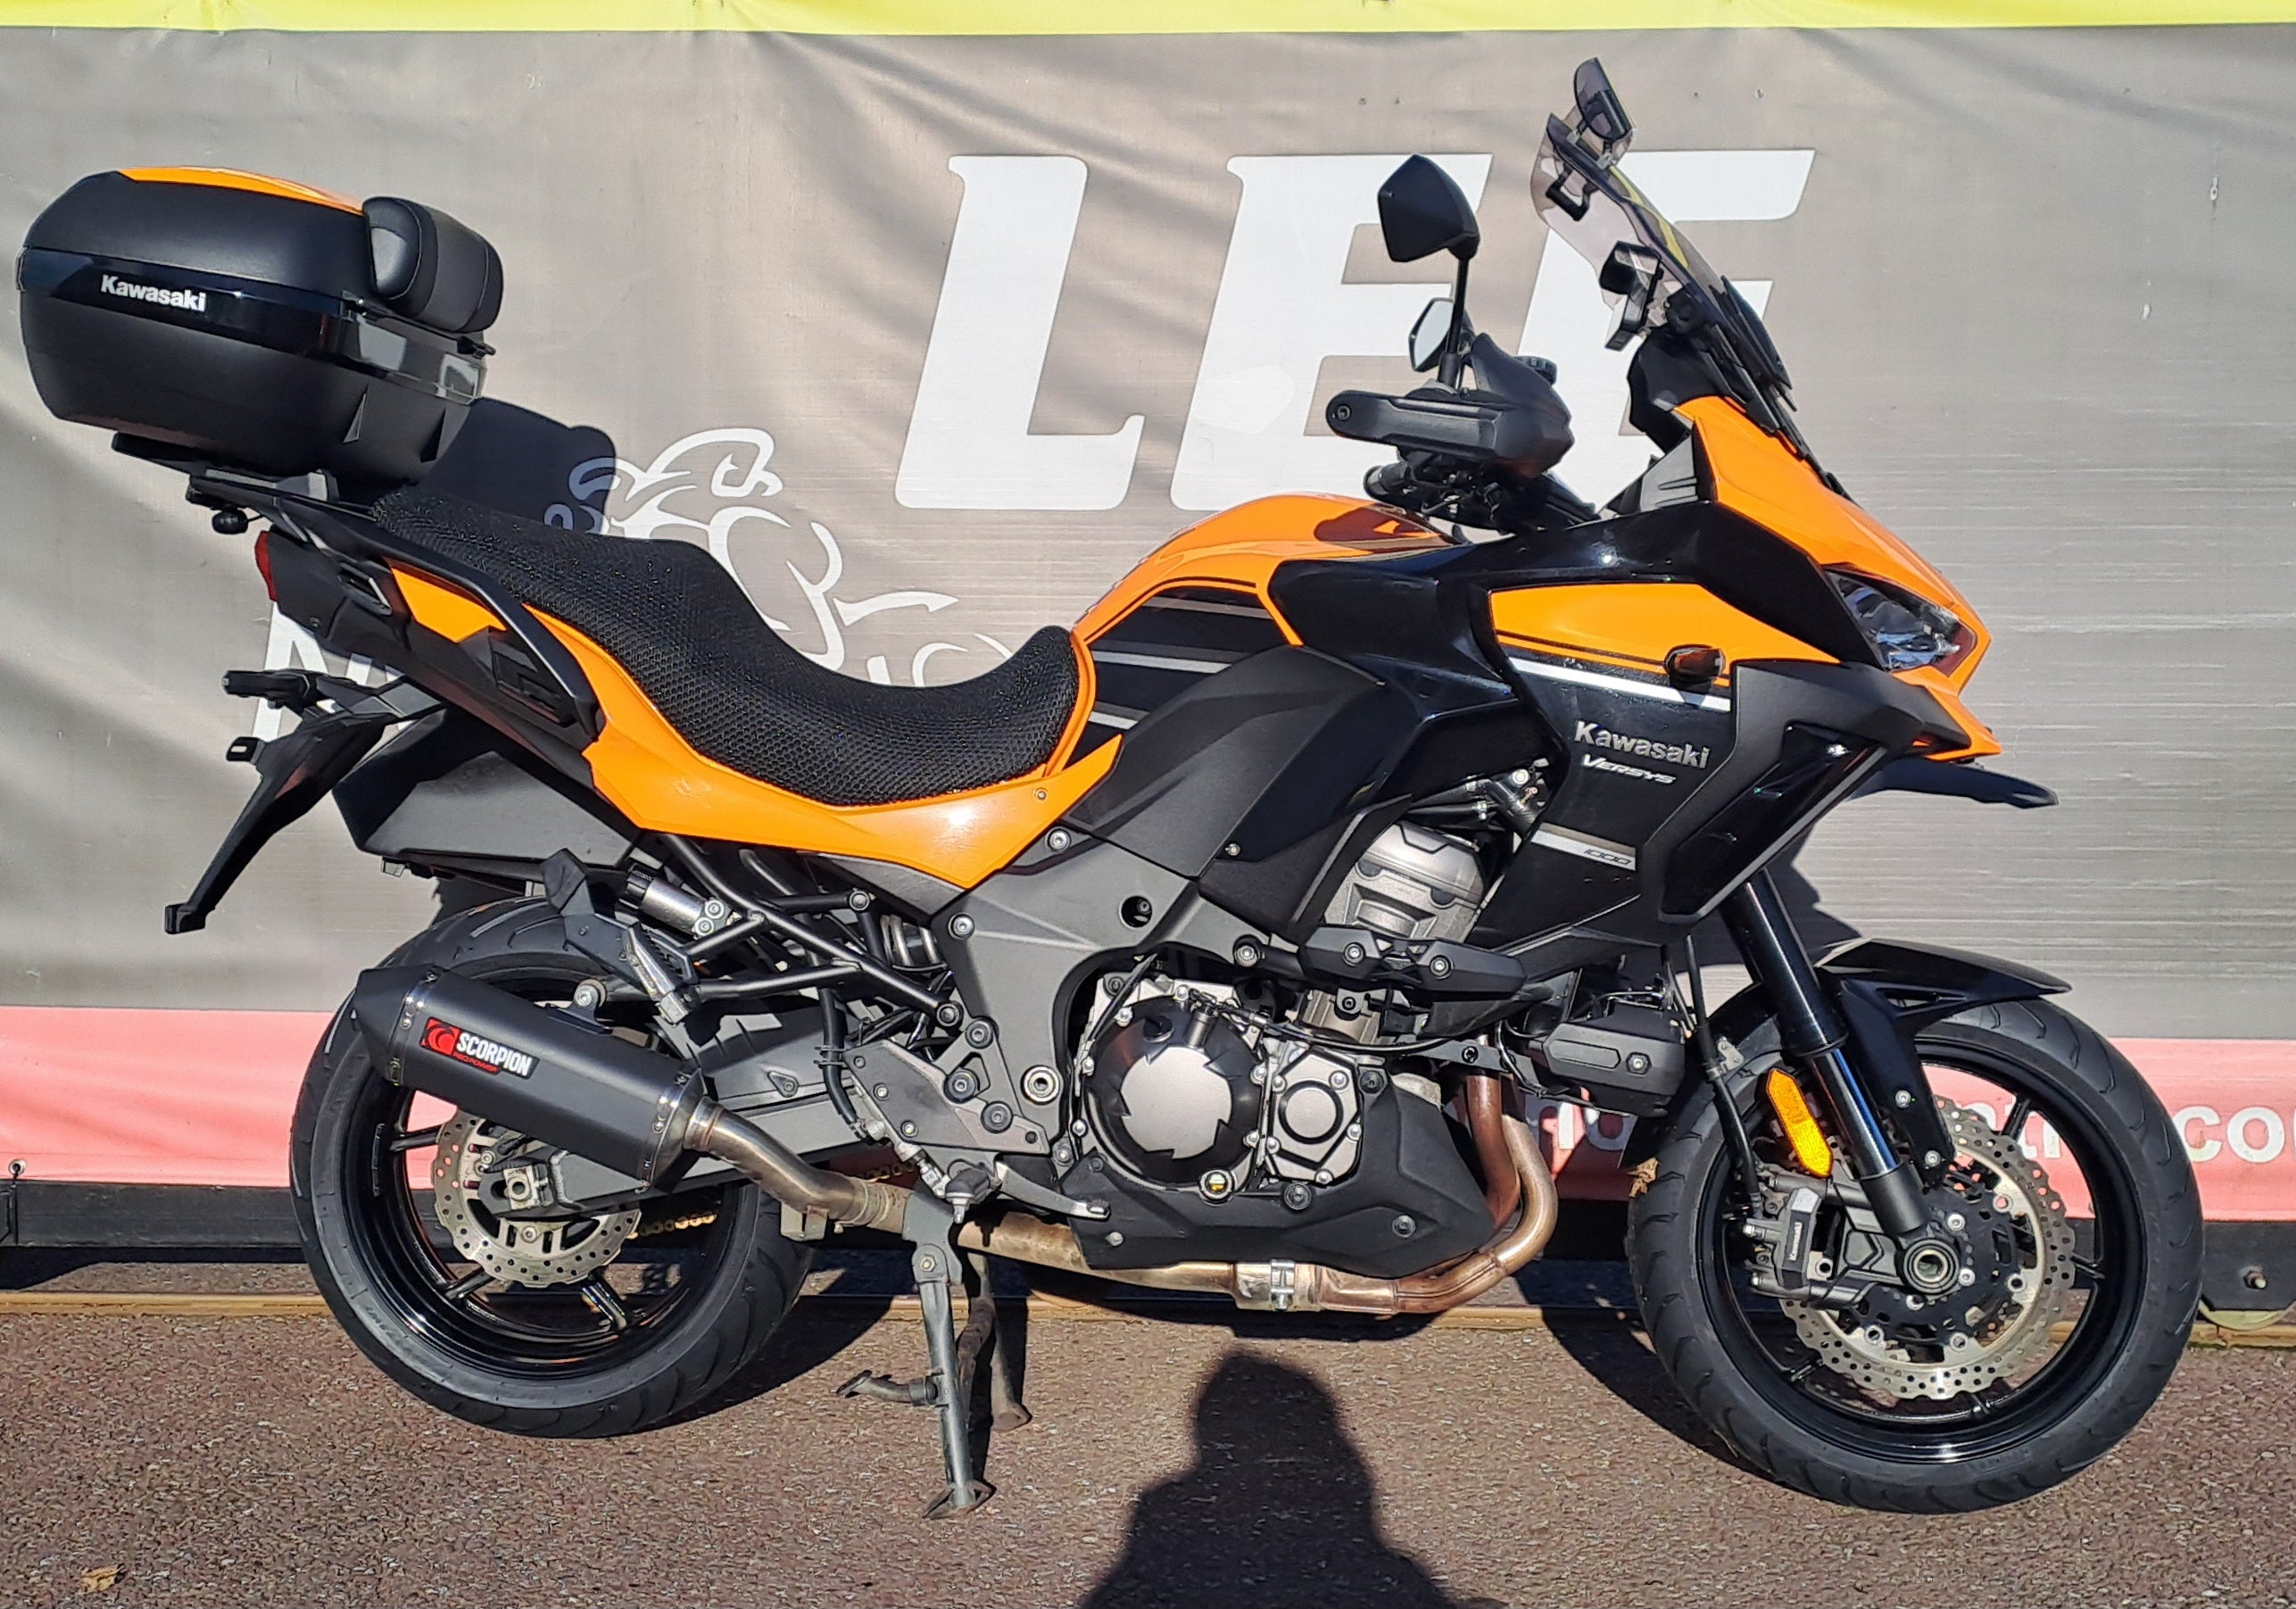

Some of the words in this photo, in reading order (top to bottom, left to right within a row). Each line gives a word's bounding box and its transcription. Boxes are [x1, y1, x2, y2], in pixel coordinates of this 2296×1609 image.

[101, 273, 206, 312] Kawasaki
[1574, 720, 1711, 769] Kawasaki
[1584, 849, 1632, 866] 1000
[456, 1032, 533, 1076] SCORPION
